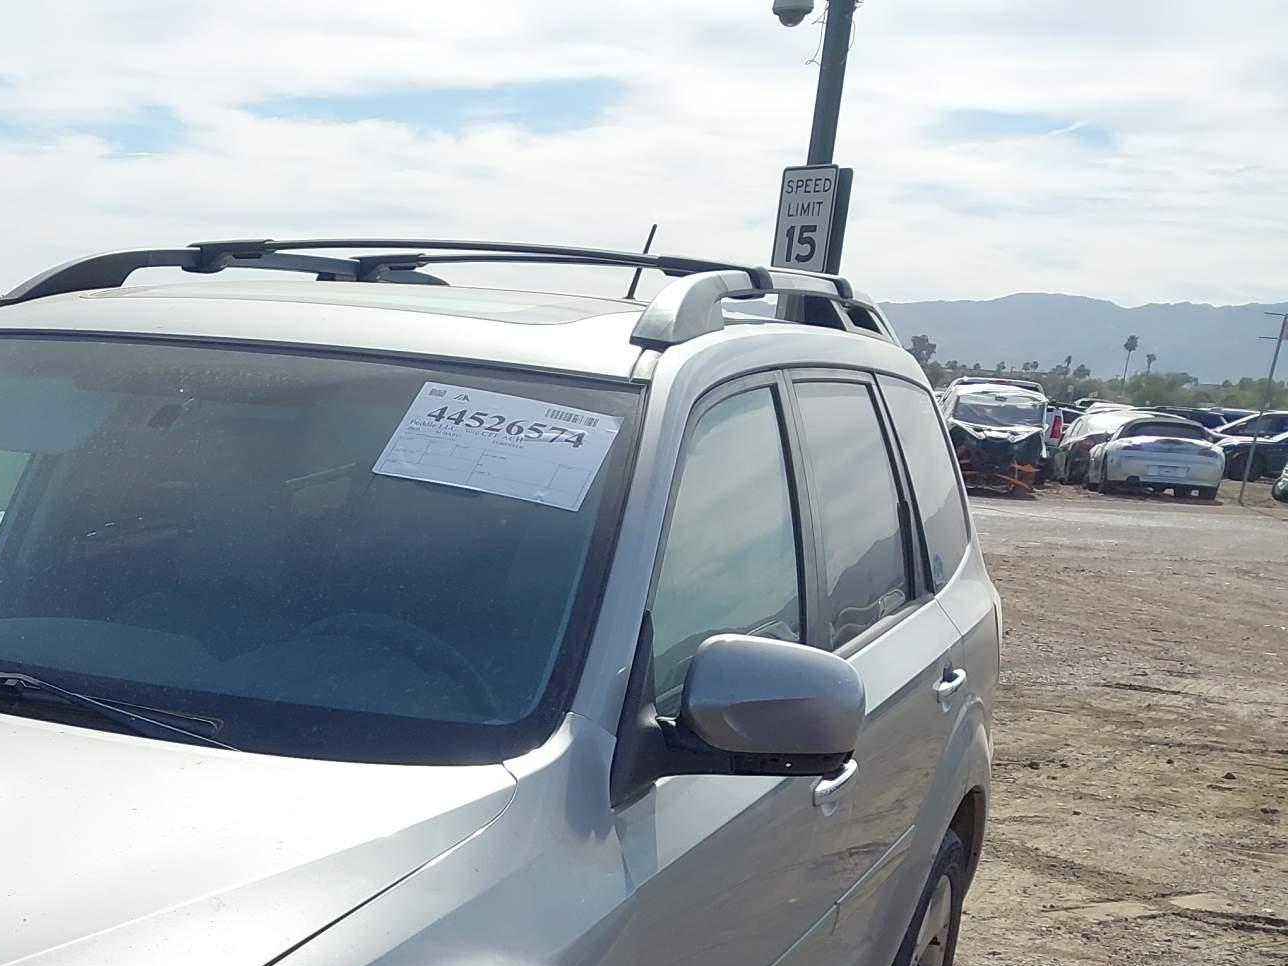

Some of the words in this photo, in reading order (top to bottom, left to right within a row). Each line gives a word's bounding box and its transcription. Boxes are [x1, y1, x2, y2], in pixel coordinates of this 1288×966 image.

[785, 178, 832, 194] SPEED
[787, 201, 824, 217] LIMIT
[785, 224, 817, 263] 15
[426, 406, 586, 448] 44526574
